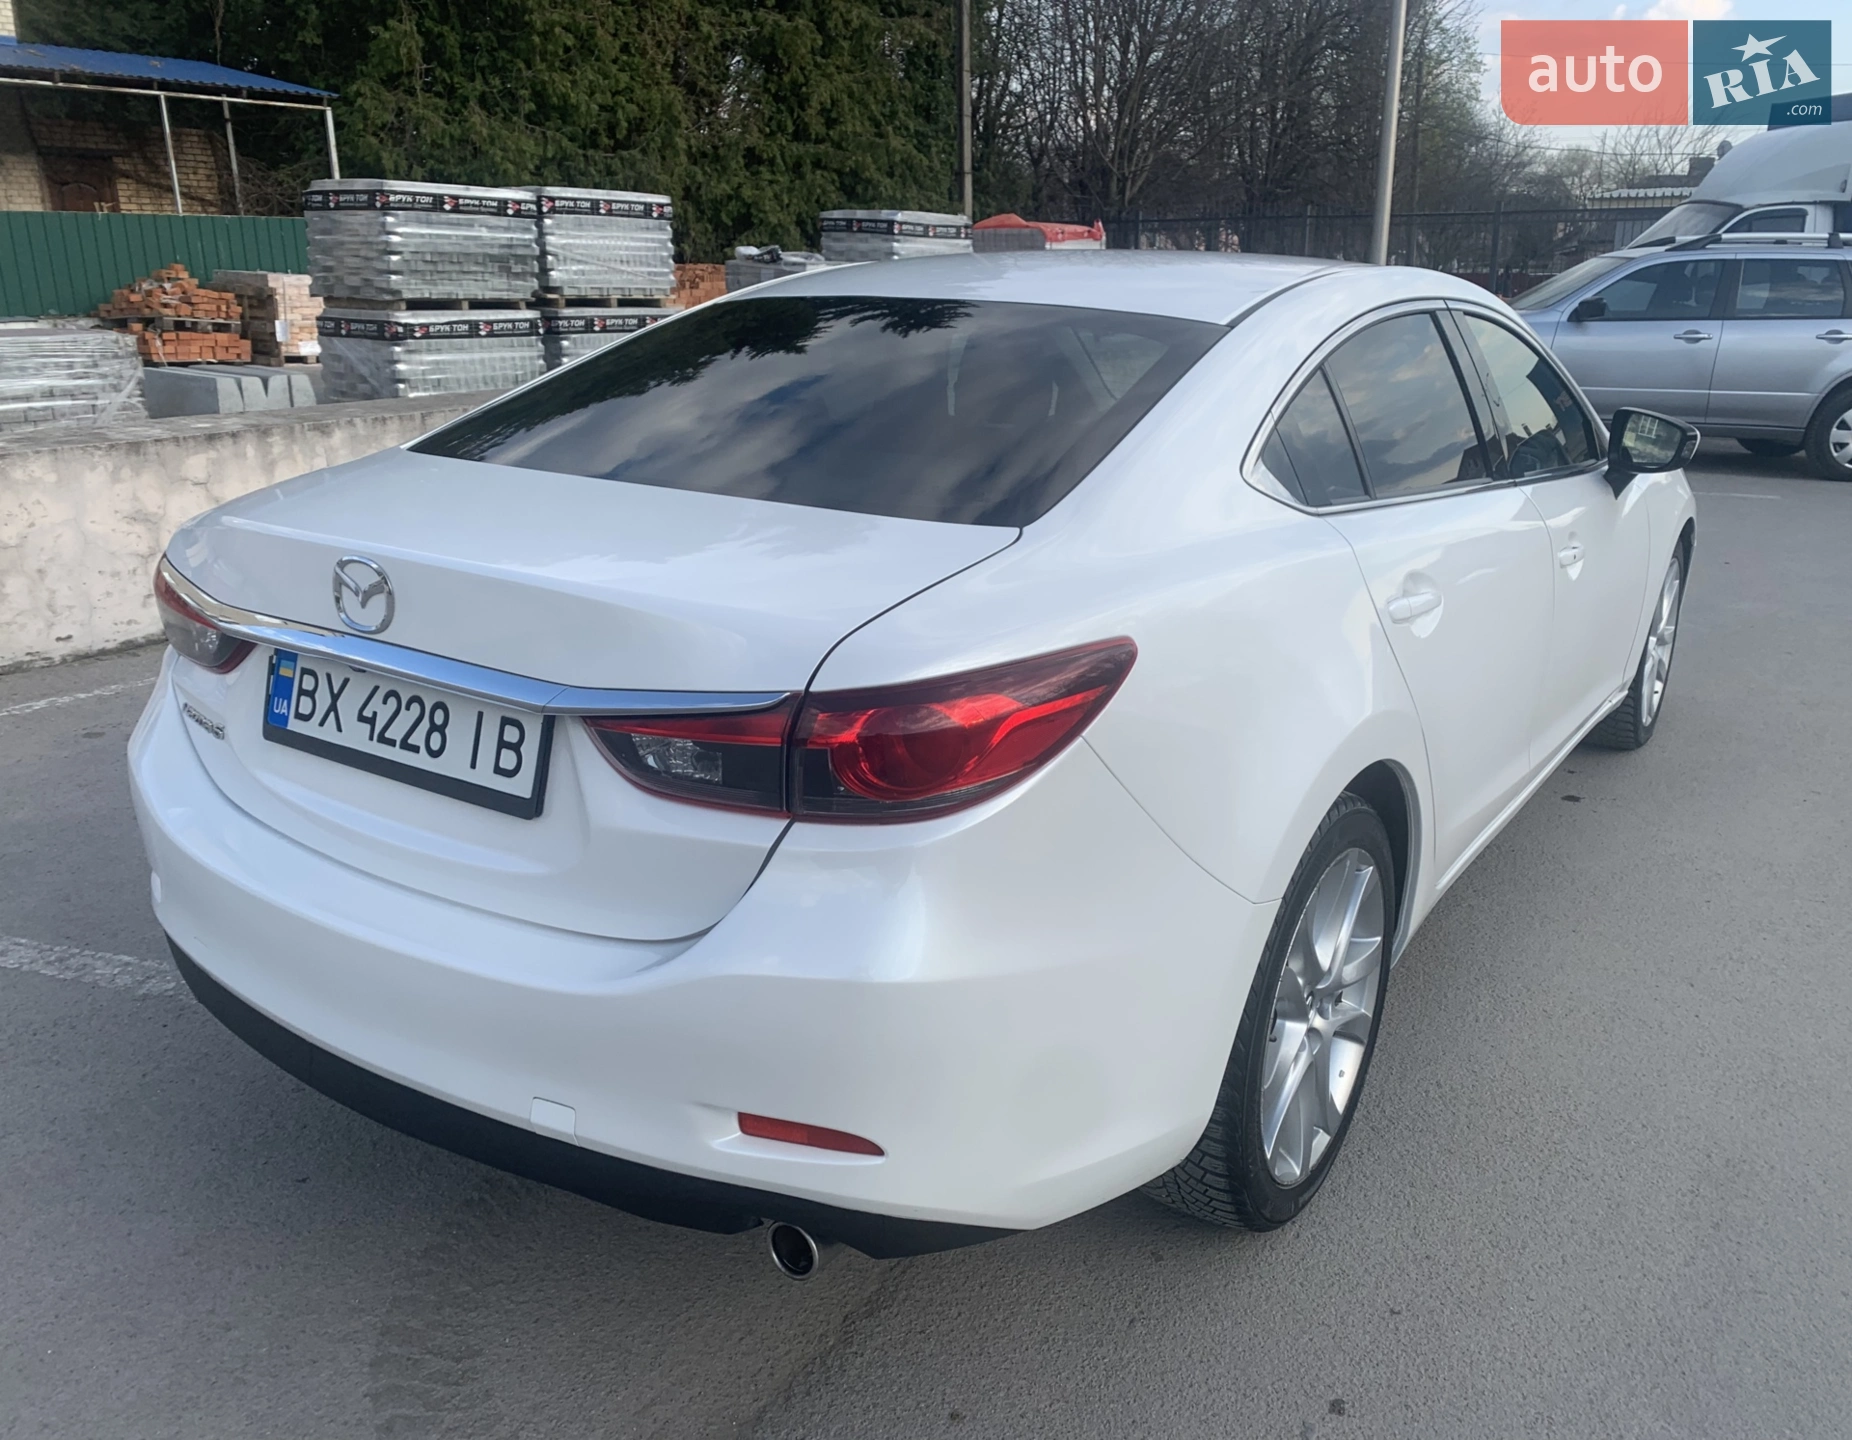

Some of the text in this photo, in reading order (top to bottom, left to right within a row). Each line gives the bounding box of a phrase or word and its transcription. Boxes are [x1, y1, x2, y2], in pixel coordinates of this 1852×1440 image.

[415, 195, 433, 203] ТОН
[428, 324, 469, 332] БРУК ТОН
[493, 321, 530, 330] БРУК ТОН
[273, 696, 288, 716] UA
[294, 666, 350, 733] BX
[357, 685, 450, 758] 4228
[469, 710, 526, 778] IB
